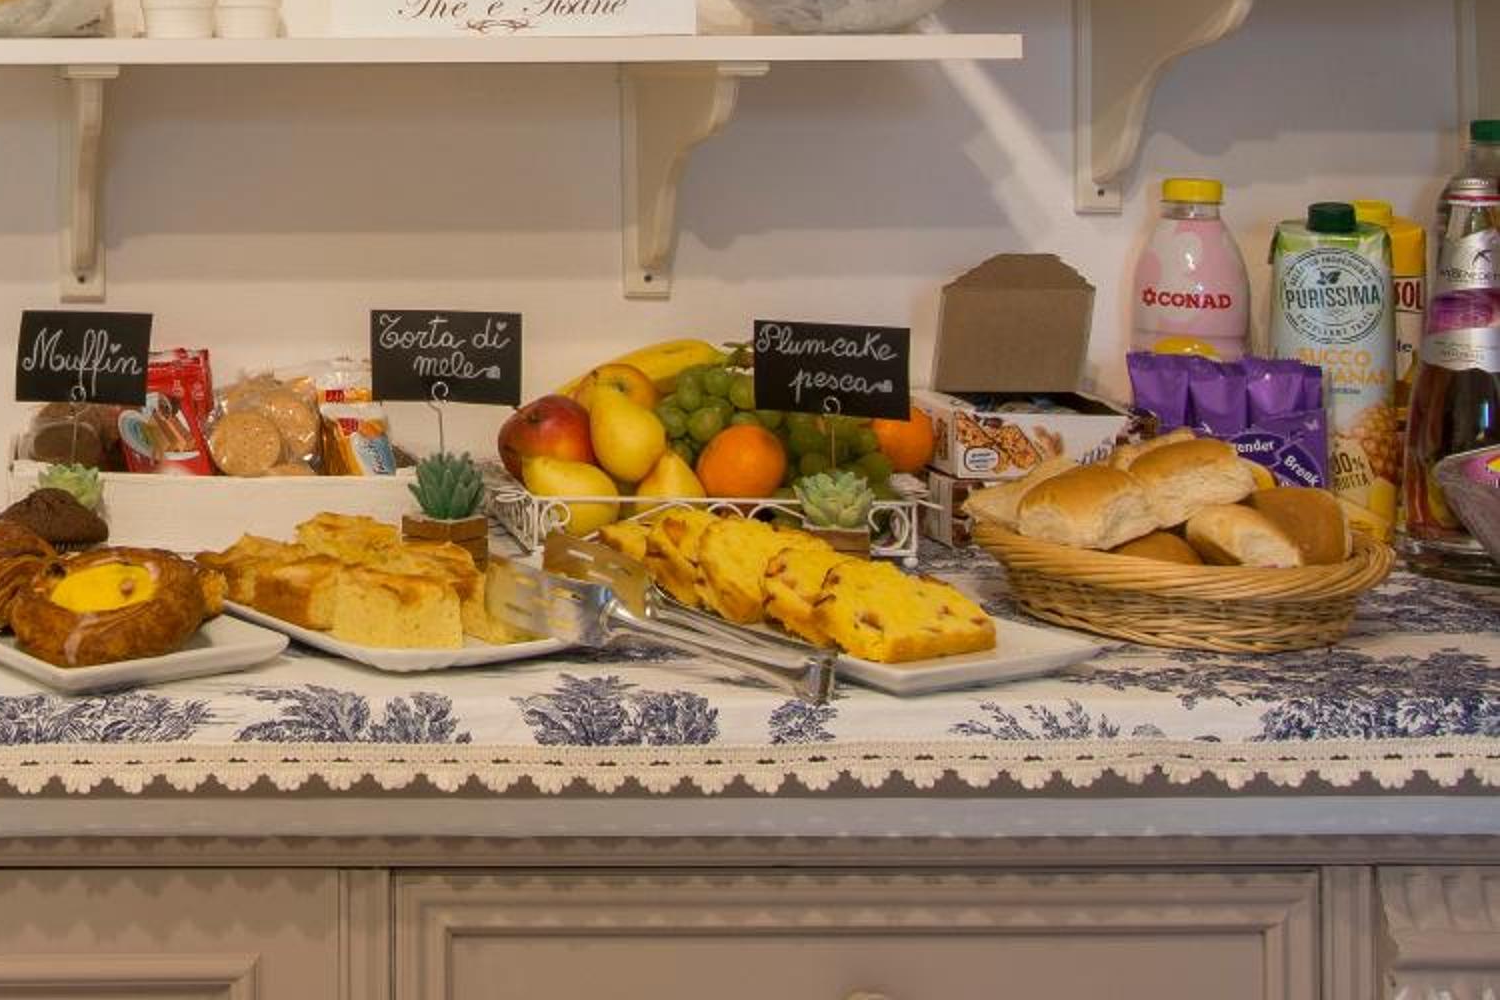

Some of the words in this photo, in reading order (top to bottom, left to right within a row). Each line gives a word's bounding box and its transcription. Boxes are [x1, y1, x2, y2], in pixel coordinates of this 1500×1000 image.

[487, 0, 504, 16] e
[1157, 291, 1232, 309] CONAD
[1285, 284, 1381, 310] PURISSIMA
[379, 312, 467, 349] Torta
[472, 317, 512, 349] di
[21, 326, 143, 398] Muffin
[413, 350, 484, 379] mele
[788, 367, 878, 405] pesca
[1236, 438, 1275, 454] ender
